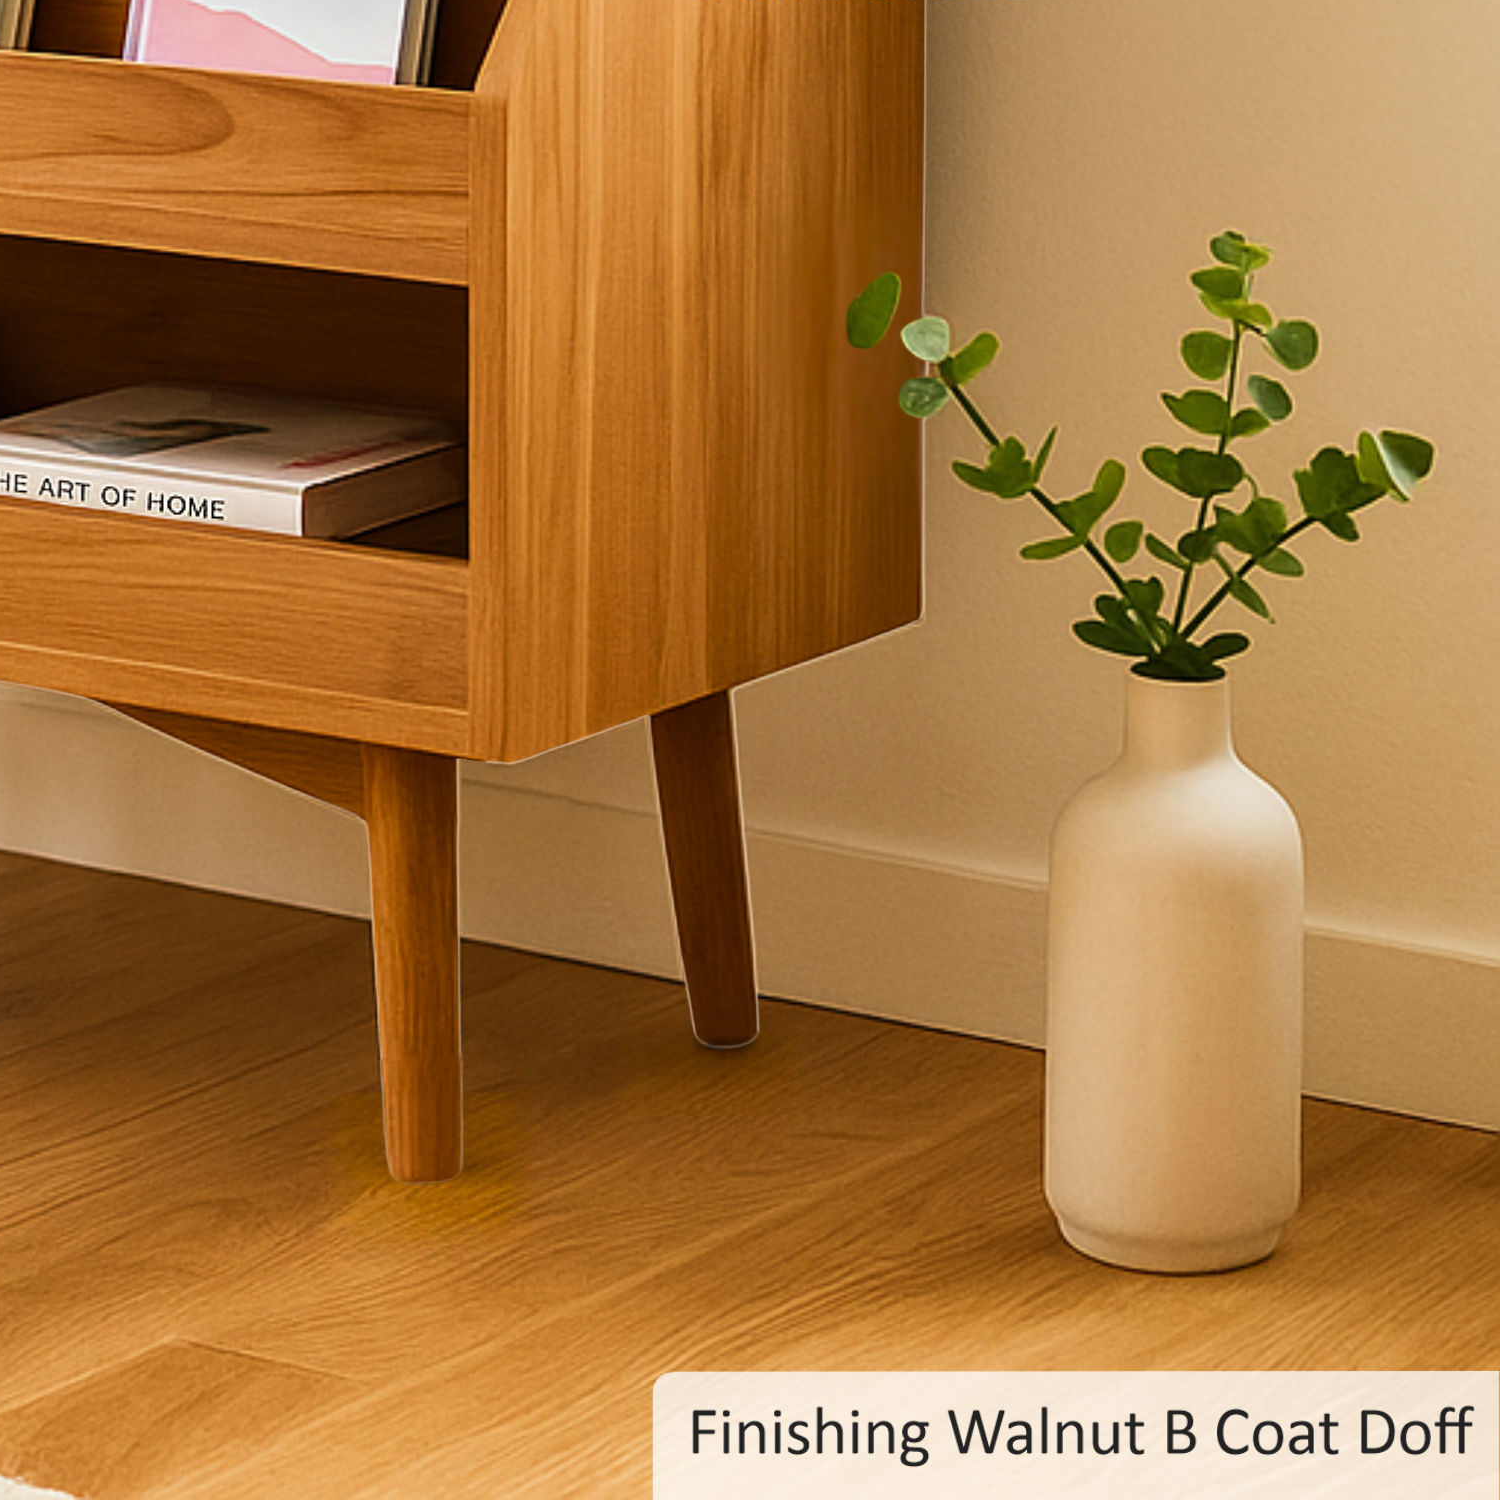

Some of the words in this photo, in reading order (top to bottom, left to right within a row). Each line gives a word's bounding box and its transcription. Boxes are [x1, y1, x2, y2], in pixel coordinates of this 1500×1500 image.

[38, 477, 91, 503] ART
[100, 485, 136, 509] OF
[147, 492, 226, 521] HOME
